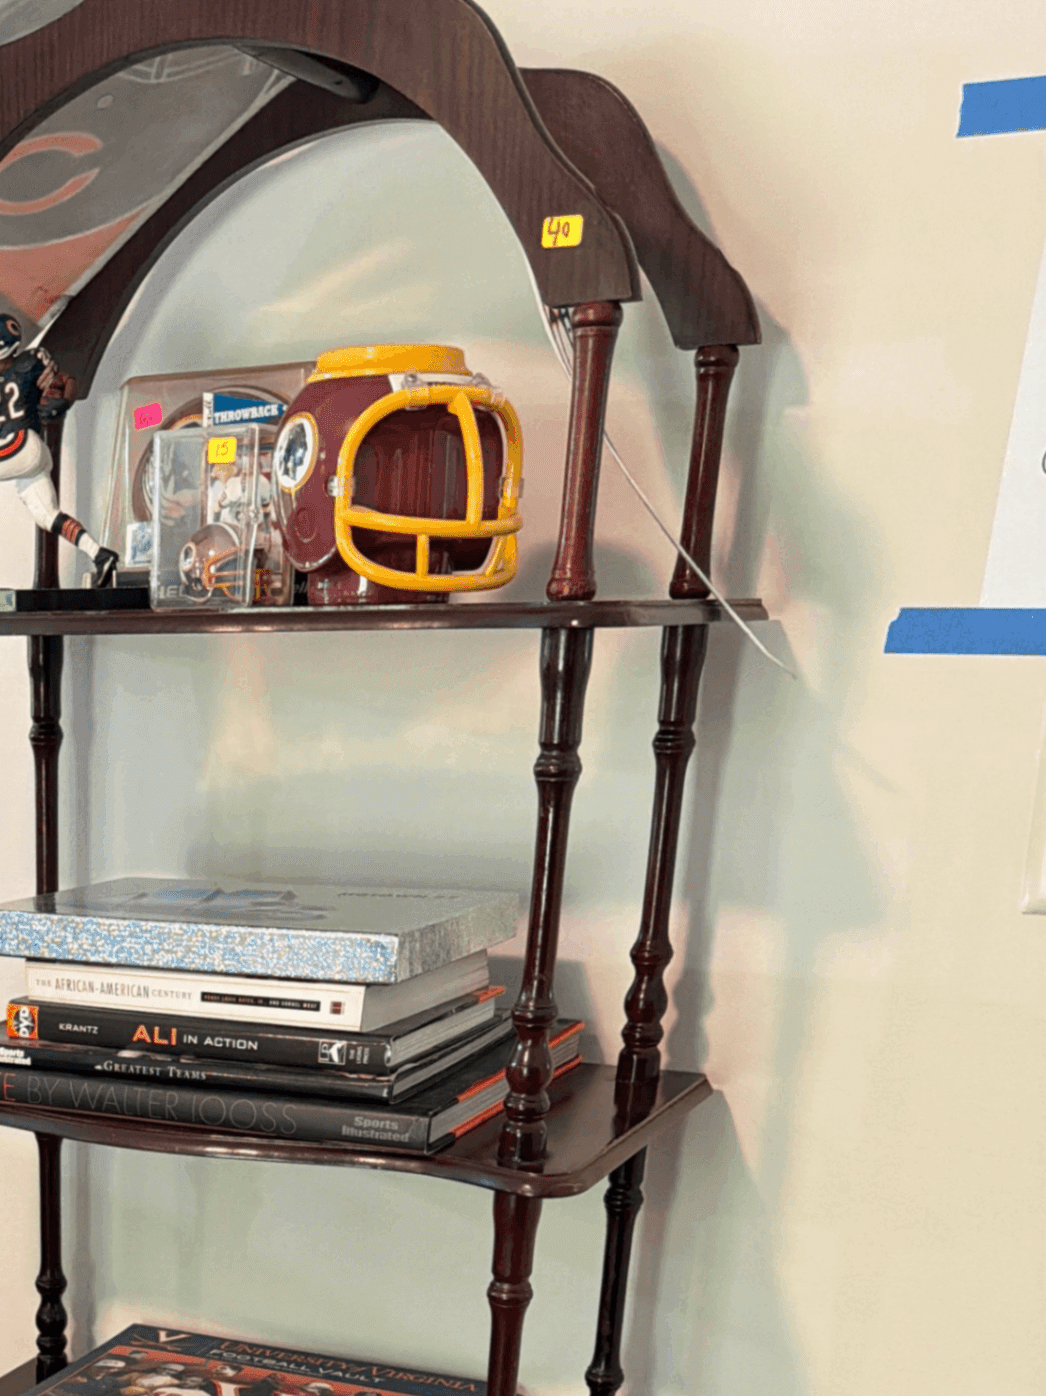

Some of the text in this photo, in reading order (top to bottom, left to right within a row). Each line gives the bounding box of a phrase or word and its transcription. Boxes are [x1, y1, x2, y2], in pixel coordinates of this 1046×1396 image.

[547, 217, 571, 248] 40
[212, 403, 279, 424] THROWBACK
[55, 978, 149, 998] AFRICAN-AMERICAN
[151, 988, 193, 1000] CENTURY
[58, 1023, 259, 1051] KRANTZ ALI IN ACTION
[103, 1061, 207, 1081] GREATEST TEAMS
[27, 1075, 61, 1105] BY
[69, 1080, 179, 1121] WALTER
[192, 1093, 298, 1135] IOOSS
[341, 1125, 411, 1143] Illustrated
[354, 1116, 400, 1131] Sports
[208, 1349, 311, 1373] FOOTBALL
[318, 1367, 387, 1384] VAULT
[219, 1340, 355, 1371] UNIVERSITY
[368, 1365, 477, 1393] VIRGINIA
